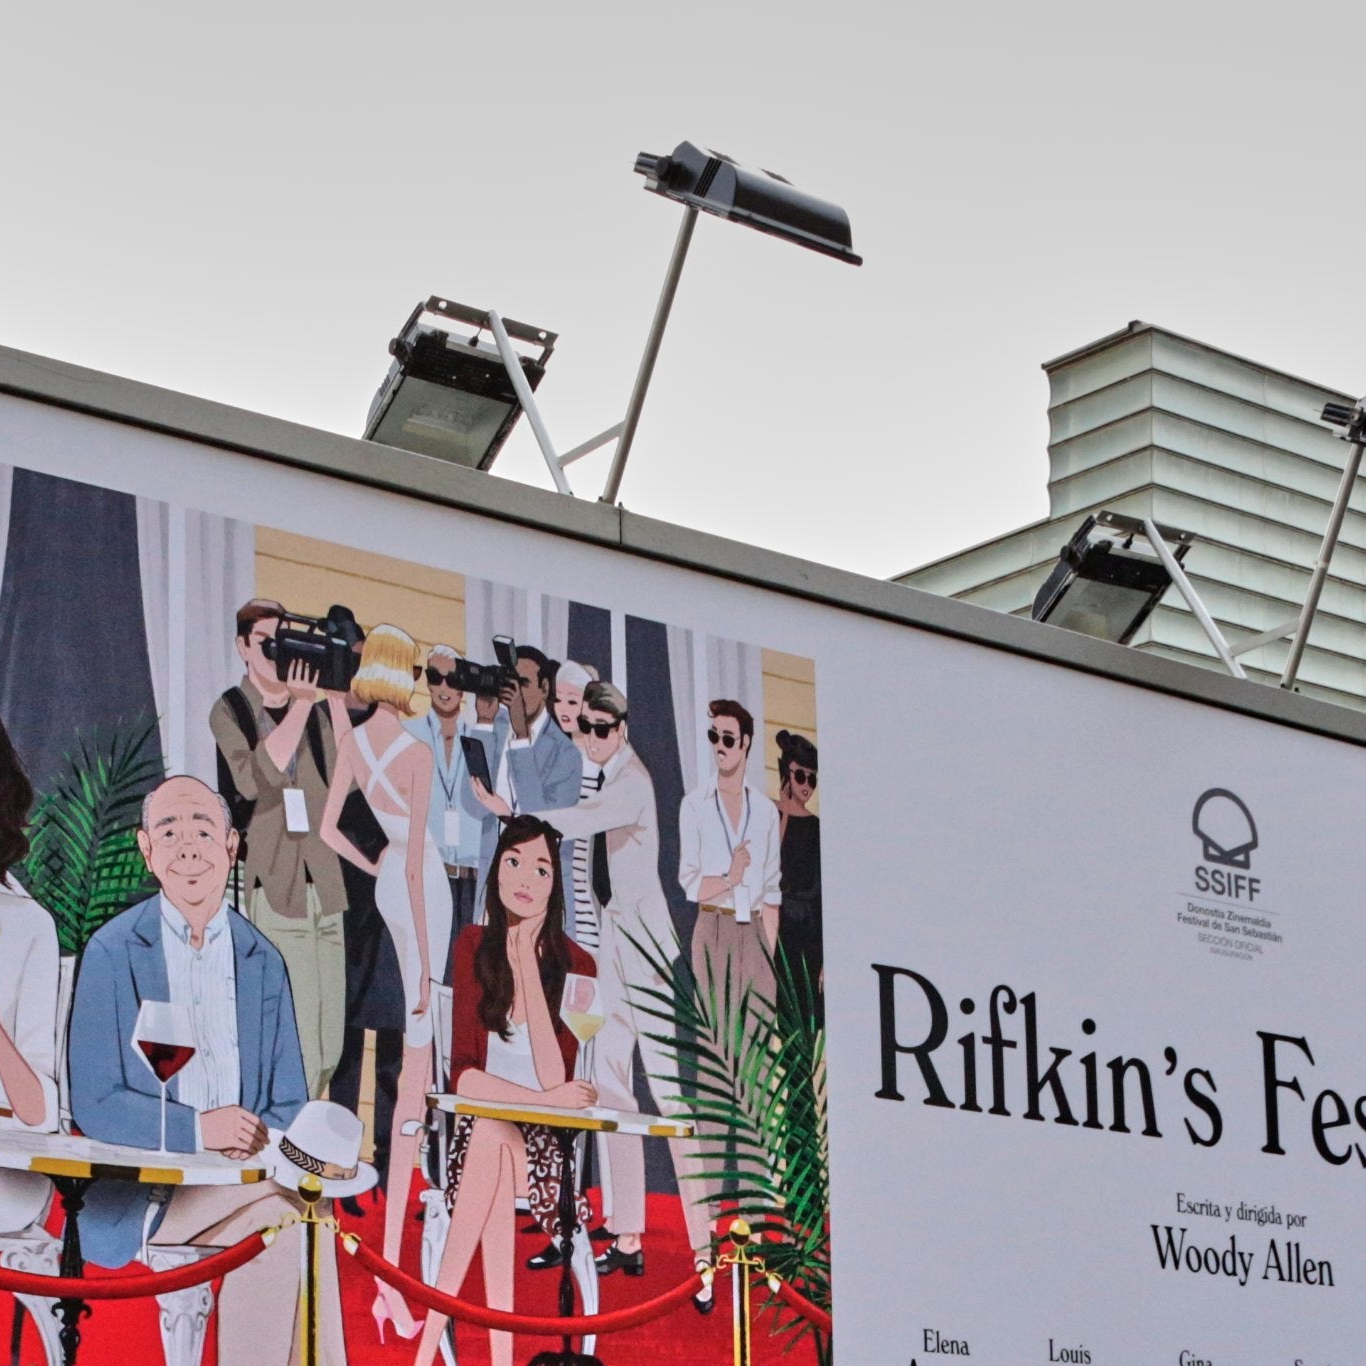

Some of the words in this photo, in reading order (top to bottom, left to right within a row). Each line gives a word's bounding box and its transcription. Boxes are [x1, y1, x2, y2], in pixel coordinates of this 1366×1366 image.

[1195, 865, 1261, 902] SSIFF
[1177, 912, 1210, 928] Festival
[1212, 921, 1222, 931] de
[1224, 922, 1241, 934] San
[1187, 902, 1225, 919] Donostia
[1176, 1192, 1222, 1218] Escrita
[1225, 1206, 1233, 1222] y
[1236, 1201, 1283, 1227] dirigida
[1286, 1213, 1307, 1230] por
[1150, 1224, 1254, 1286] Woody
[1262, 1238, 1335, 1287] Allen
[922, 1328, 971, 1356] Elena
[1048, 1338, 1091, 1364] Louis
